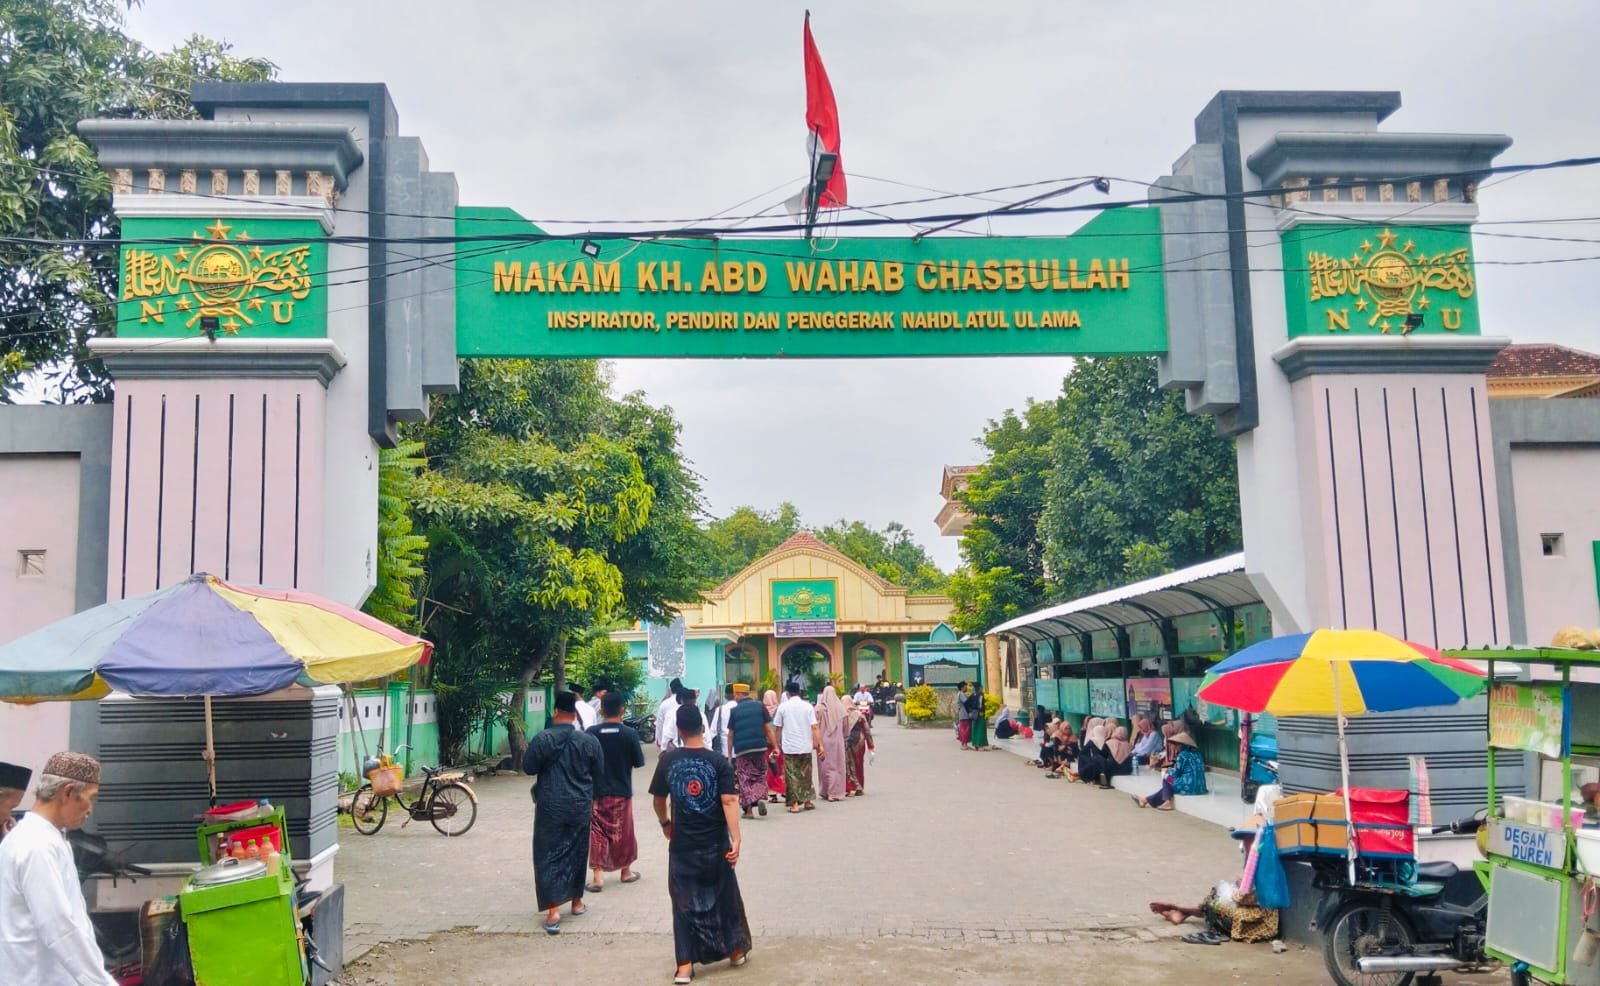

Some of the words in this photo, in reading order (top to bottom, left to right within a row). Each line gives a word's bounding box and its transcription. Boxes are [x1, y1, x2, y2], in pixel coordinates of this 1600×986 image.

[494, 261, 621, 292] MAKAM
[638, 262, 692, 292] KH.
[701, 262, 767, 292] ABD
[786, 261, 904, 292] WAHAB
[916, 259, 1129, 291] CHASBULLAH
[140, 301, 165, 323] N
[271, 301, 295, 324] U
[548, 312, 660, 332] INSPIRATOR,
[666, 312, 738, 329] PENDIRI
[743, 312, 780, 329] DAN
[787, 312, 894, 329] PENGGERAK
[1014, 311, 1081, 328] ULAMA
[1327, 309, 1349, 330] N
[1441, 309, 1461, 329] U
[1504, 827, 1547, 848] DEGAN
[1512, 845, 1552, 866] DUREN
